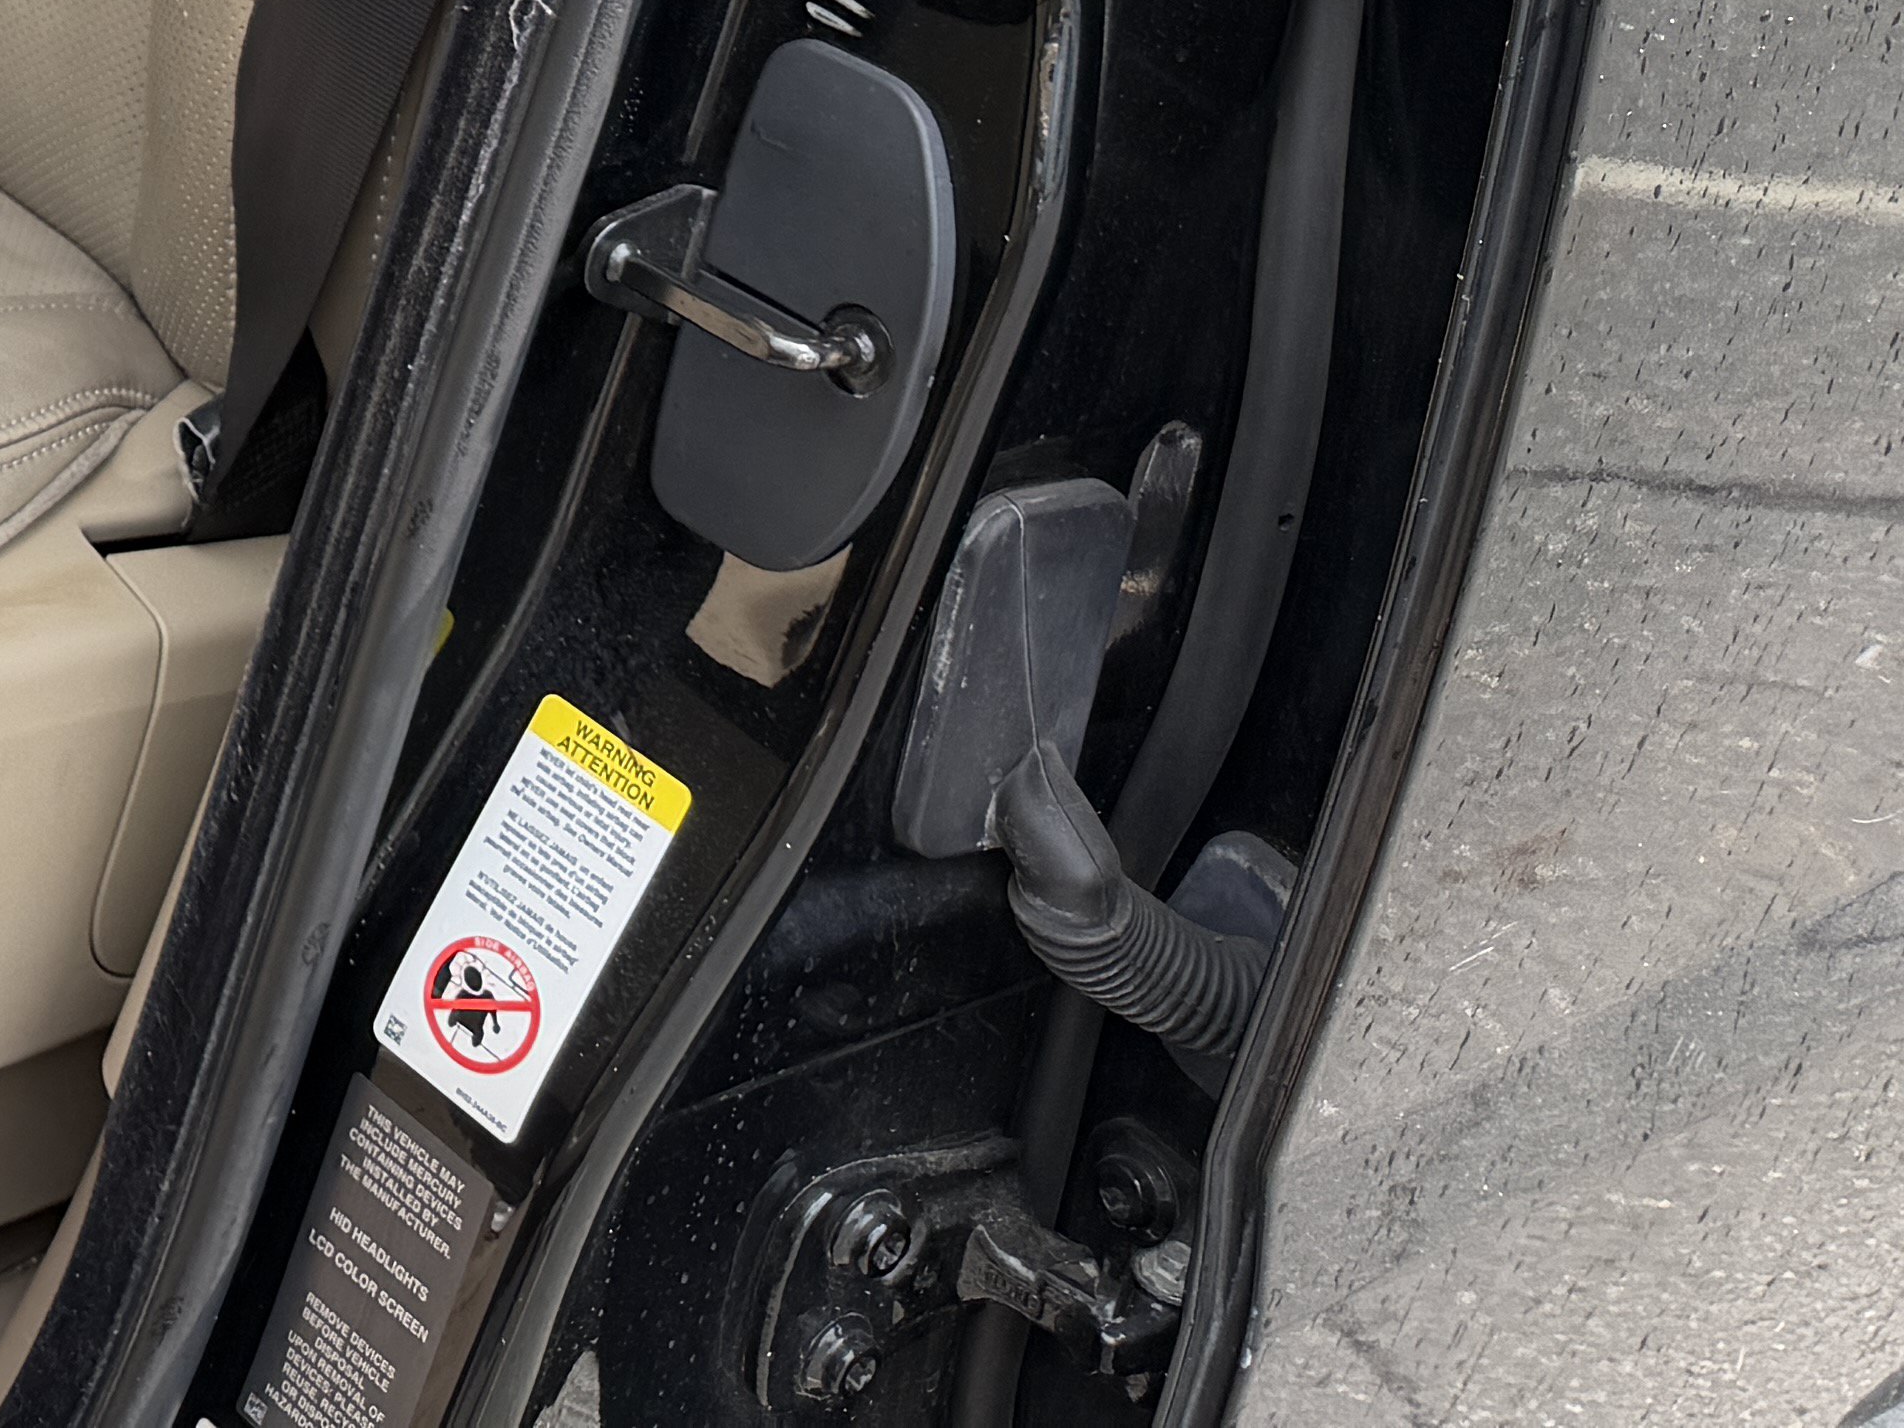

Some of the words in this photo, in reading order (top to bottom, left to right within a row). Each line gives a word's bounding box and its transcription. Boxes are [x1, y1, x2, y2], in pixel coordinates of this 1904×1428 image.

[556, 732, 655, 811] ATTENTION
[573, 720, 657, 788] WARNING
[347, 1126, 415, 1191] CONTAINING
[414, 1182, 463, 1231] DEVICES
[358, 1117, 407, 1165] INCLUDE
[406, 1157, 462, 1211] MERCURY
[361, 1155, 422, 1213] INSTALLED
[421, 1207, 439, 1229] BY
[365, 1104, 392, 1134] THIS
[391, 1125, 439, 1174] VEHICLE
[438, 1166, 465, 1196] MAY
[338, 1153, 362, 1180] THE
[360, 1173, 453, 1260] MANUFACTURER.
[307, 1228, 335, 1260] LCD
[333, 1251, 378, 1298] COLOR
[376, 1289, 429, 1344] SCREEN
[328, 1206, 352, 1235] HID
[350, 1225, 430, 1303] HEADLIGHTS
[285, 1329, 317, 1364] UPON
[315, 1356, 368, 1411] REMOVAL
[368, 1405, 385, 1423] OF
[300, 1306, 345, 1353] BEFORE
[343, 1344, 390, 1393] VEHICLE
[304, 1291, 351, 1338] REMOVE
[349, 1331, 397, 1380] DEVICES
[313, 1335, 367, 1391] DISPOSAL
[281, 1381, 297, 1399] OR
